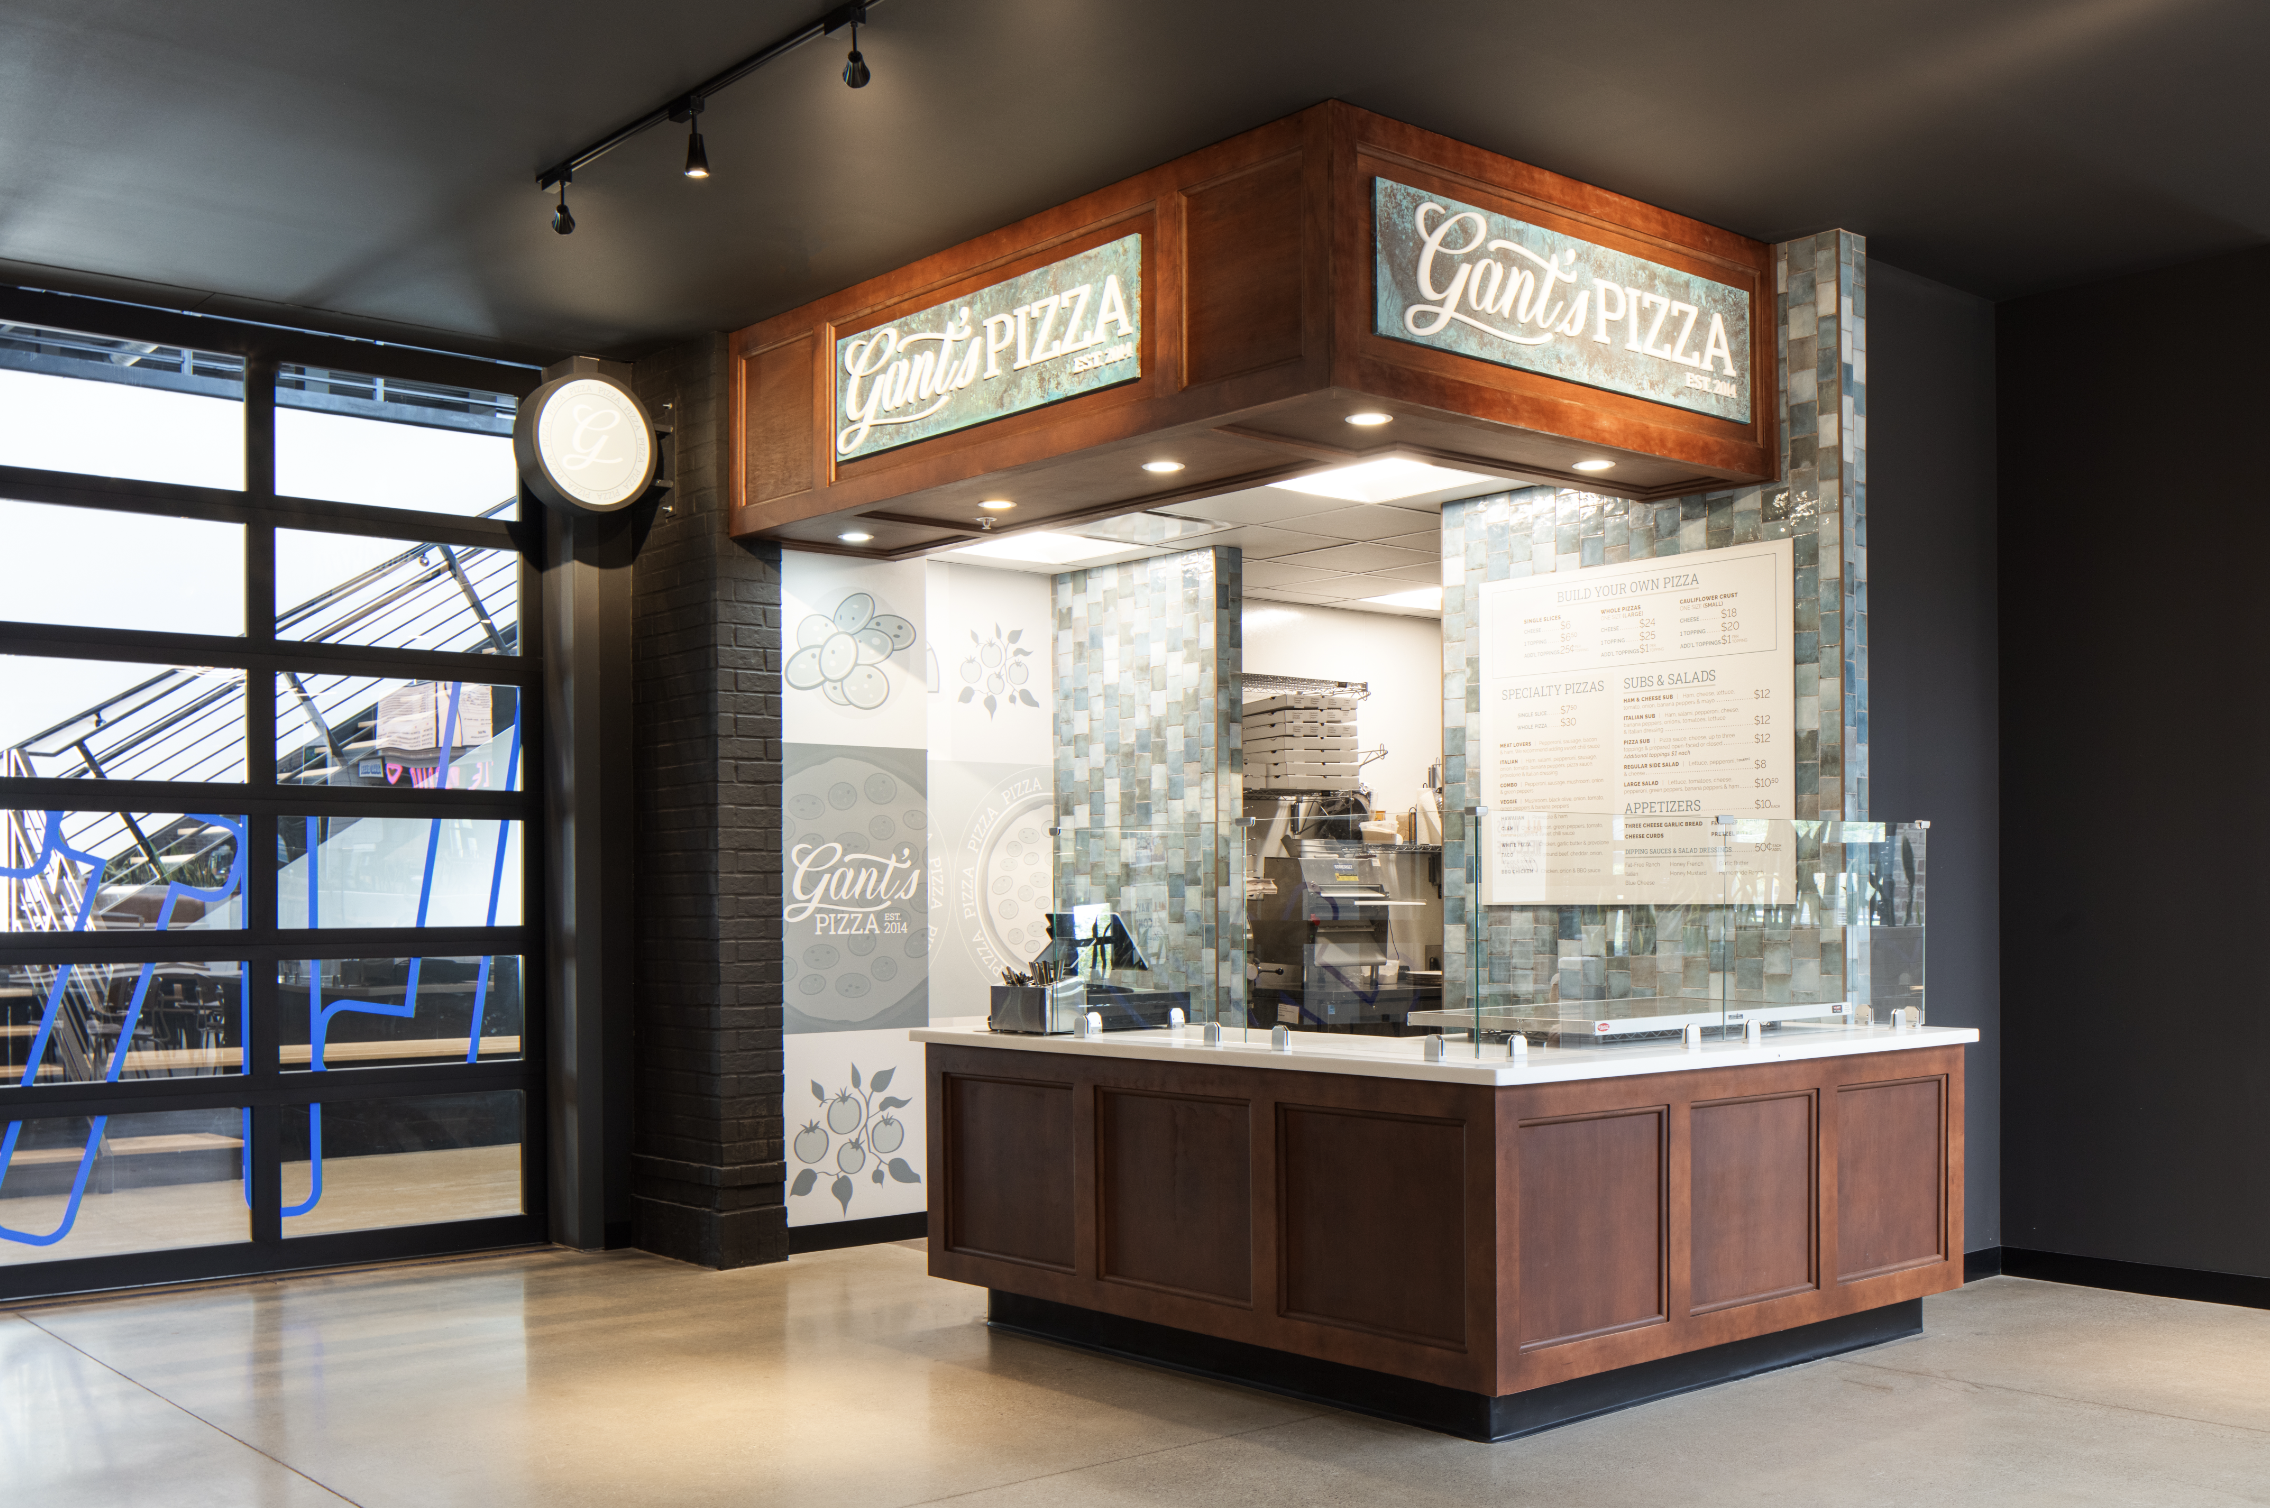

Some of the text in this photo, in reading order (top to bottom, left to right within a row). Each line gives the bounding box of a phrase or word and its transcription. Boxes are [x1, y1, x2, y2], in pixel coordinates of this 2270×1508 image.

[1404, 202, 1736, 377] Gant's PIZZA
[837, 274, 1134, 454] Gant's PIZZA
[1074, 342, 1134, 374] EST. 2014
[568, 385, 592, 395] PIZZA
[1684, 372, 1736, 398] EST. 2014
[598, 386, 620, 404] PIZZA
[624, 406, 641, 431] PIZZA
[562, 404, 622, 470] G
[638, 438, 646, 463] PIZZA
[622, 468, 642, 490] PIZZA
[1557, 573, 1699, 603] BUILD YOUR OWN PIZZA
[1679, 594, 1719, 605] CAULIFLOWER
[1703, 601, 1724, 609] (SMALL)
[1721, 607, 1737, 619] $18
[1560, 620, 1571, 630] $6
[1639, 617, 1656, 628] $24
[1721, 620, 1740, 632] $20
[1639, 630, 1656, 641] $25
[1623, 669, 1716, 690] SUBS & SALADS
[1501, 680, 1605, 701] SPECIALTY PIZZAS
[1753, 688, 1771, 700] $12
[1560, 717, 1577, 727] $30
[1754, 714, 1771, 726] $12
[1754, 733, 1771, 744] $12
[1754, 759, 1766, 770] $8
[1624, 799, 1701, 814] APPETIZERS
[1754, 798, 1772, 810] $10
[1755, 842, 1772, 852] 50¢
[784, 842, 920, 922] Gant's
[929, 856, 944, 910] PIZZA
[962, 778, 1042, 978] PIZZA PIZZA PIZZA PIZZA
[815, 912, 902, 934] PIZZA EST.
[884, 922, 908, 934] 2014
